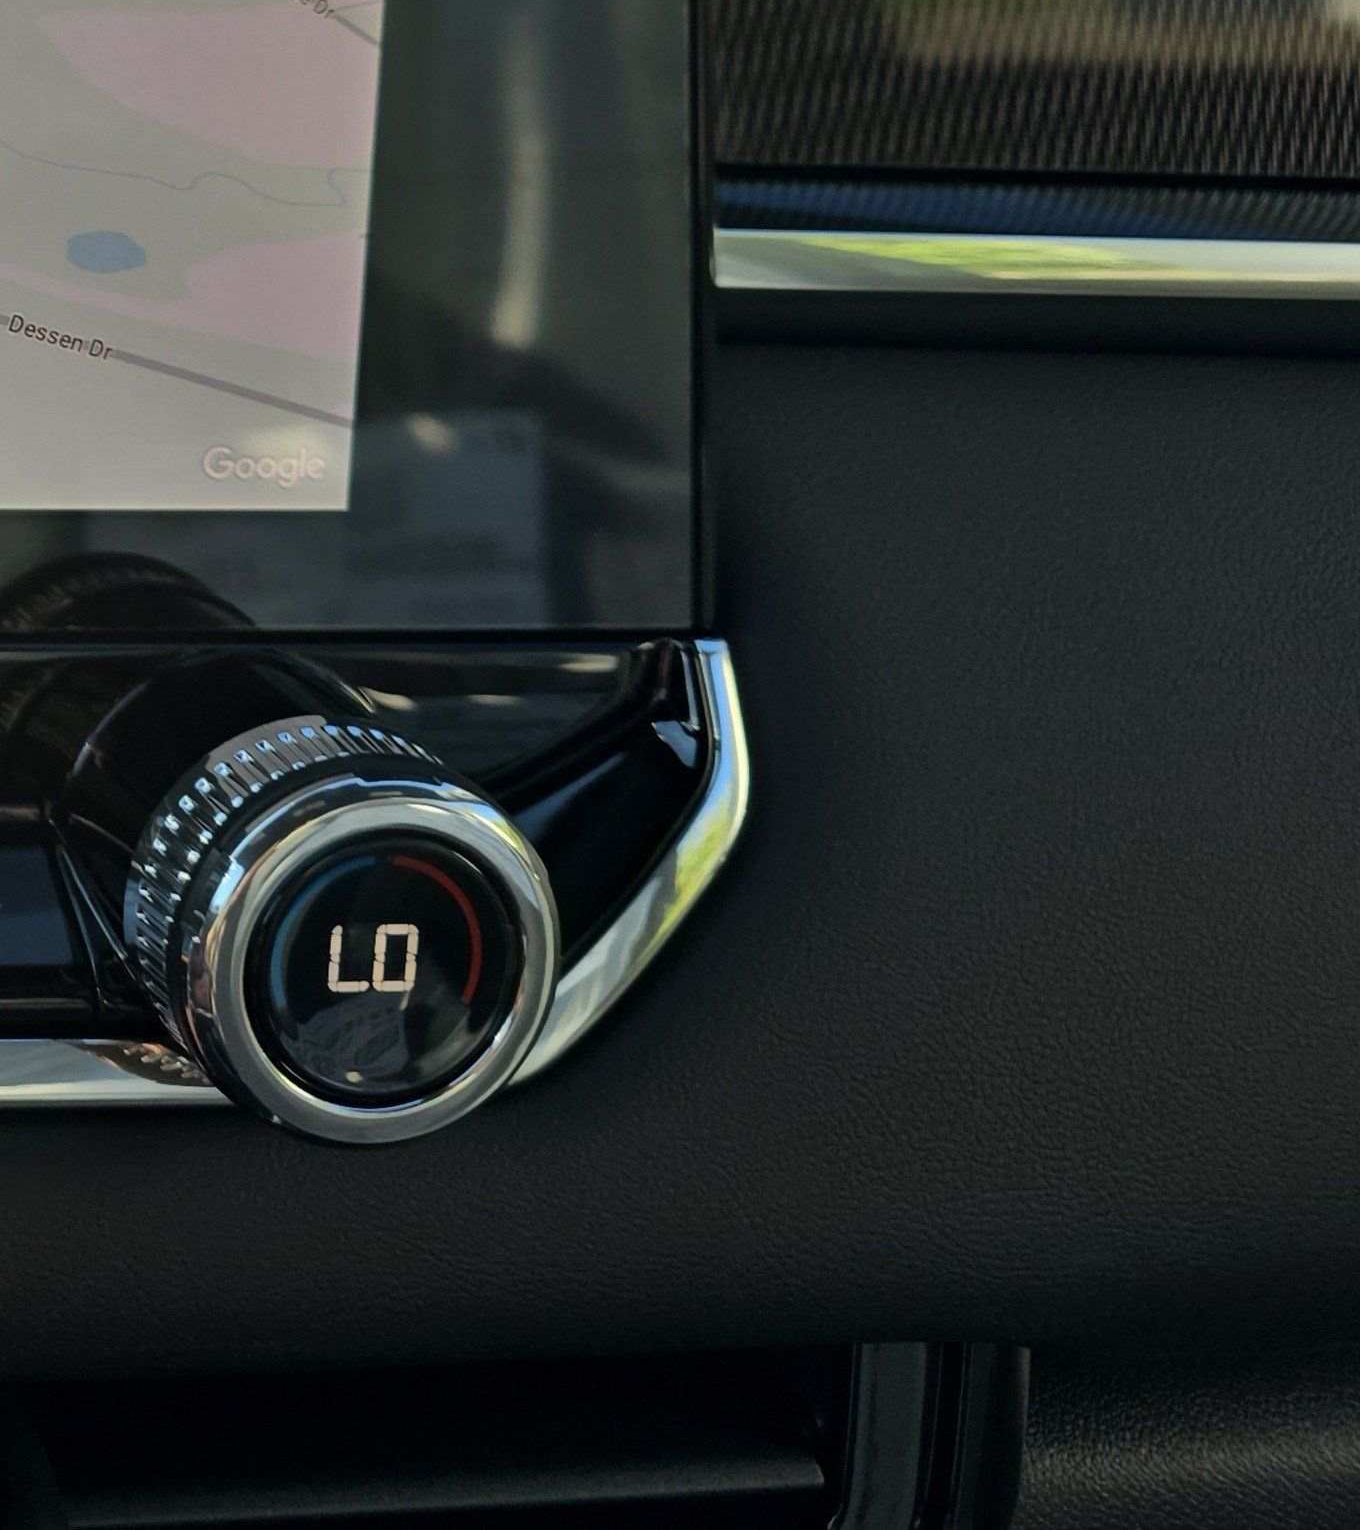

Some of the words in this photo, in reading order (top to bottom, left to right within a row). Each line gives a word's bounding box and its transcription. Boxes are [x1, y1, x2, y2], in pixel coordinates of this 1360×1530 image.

[8, 315, 84, 352] Dessen
[88, 339, 114, 361] Dr
[203, 444, 326, 488] Google
